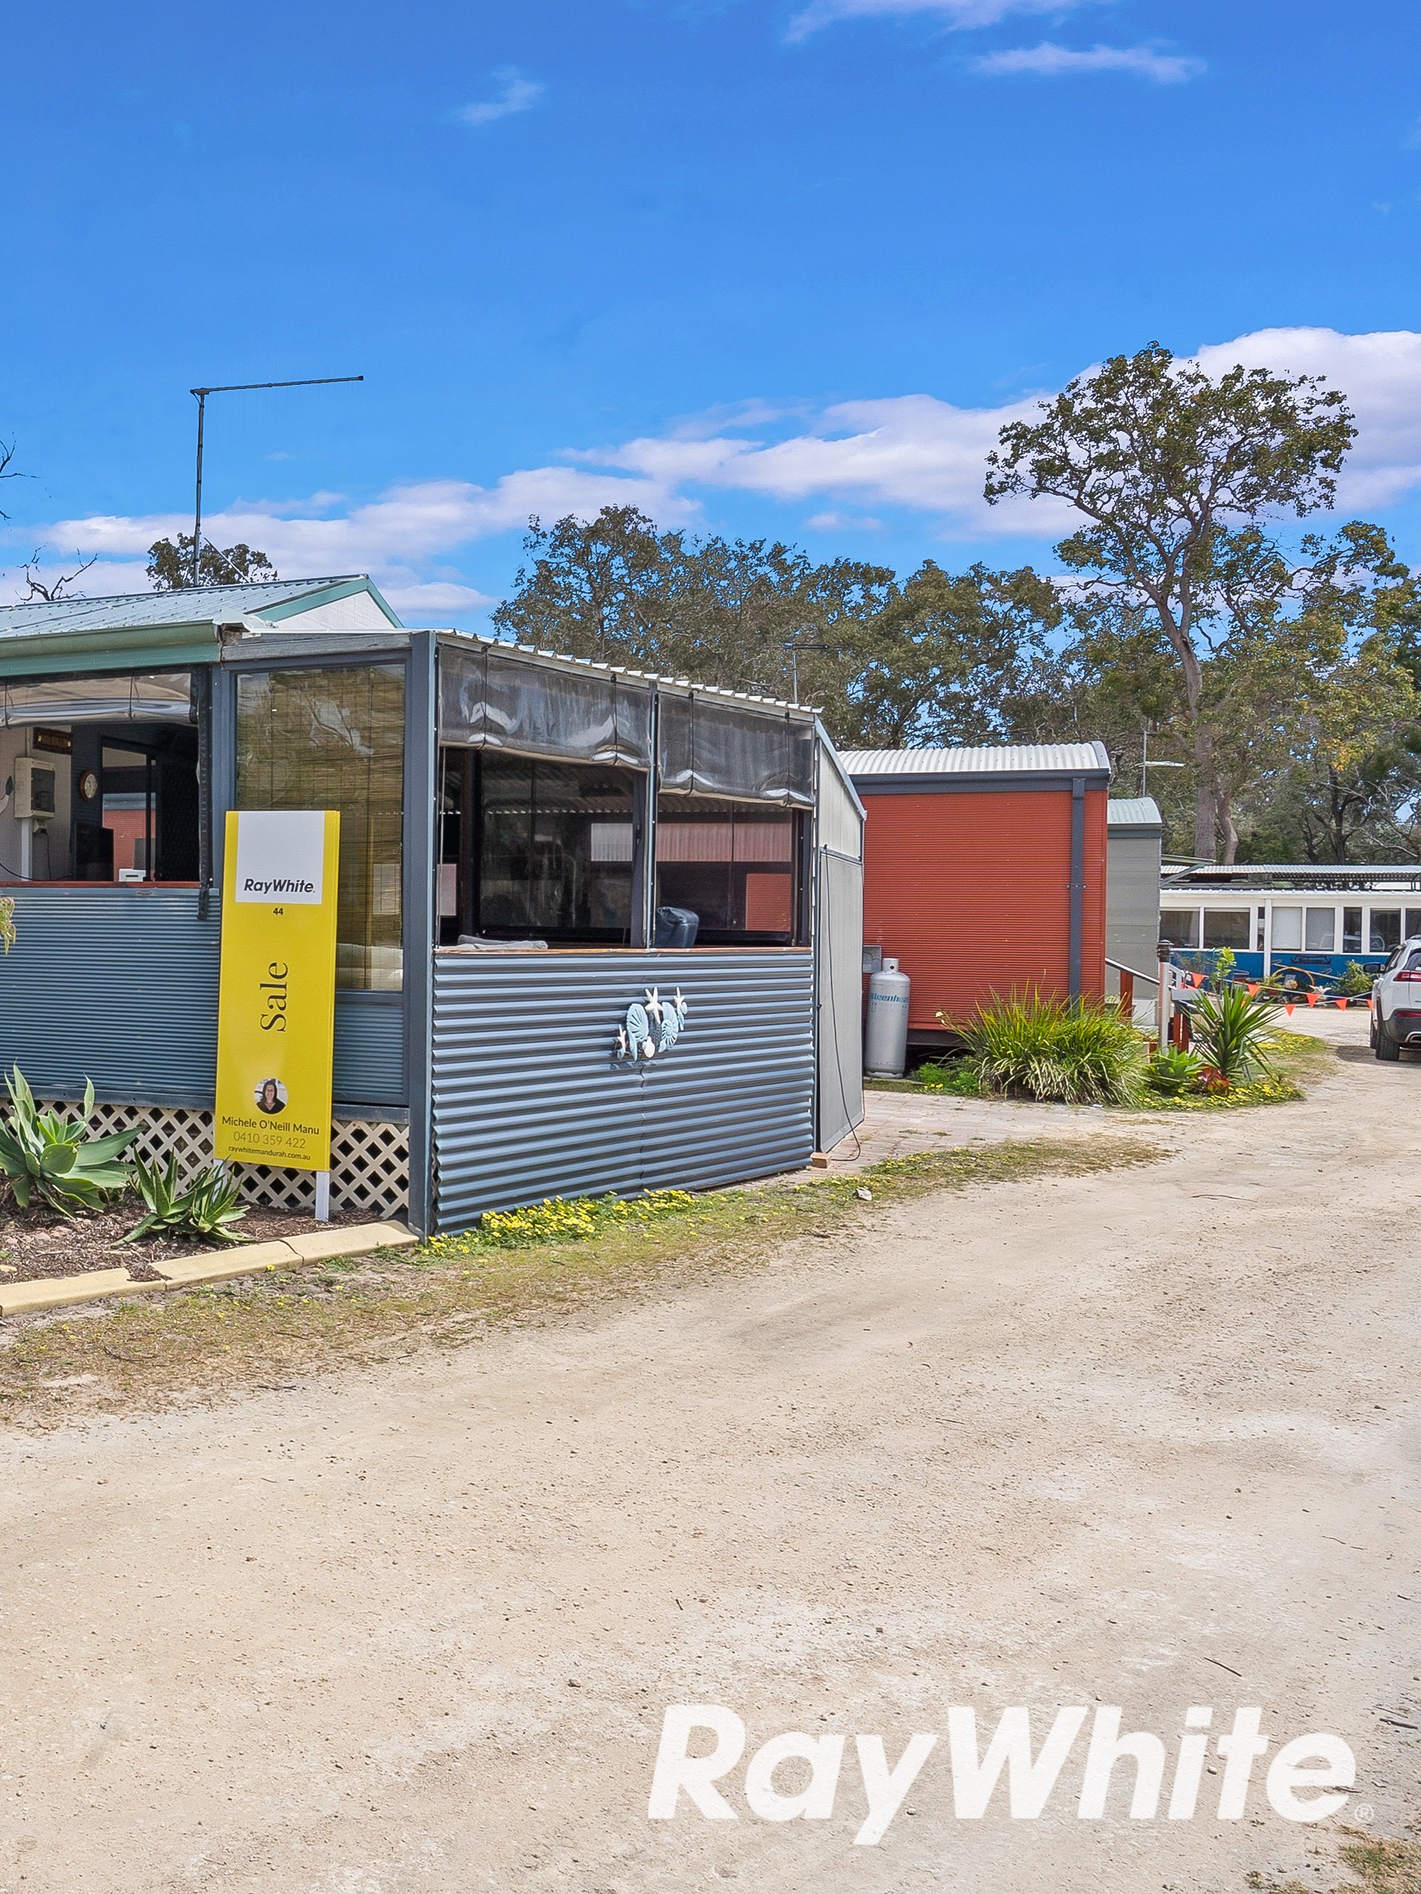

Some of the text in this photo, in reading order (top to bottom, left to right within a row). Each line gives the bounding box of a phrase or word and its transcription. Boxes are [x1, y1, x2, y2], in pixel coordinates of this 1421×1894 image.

[273, 907, 284, 915] 44
[259, 962, 288, 1032] Sale
[222, 1116, 320, 1135] Michele O'Neill Manu
[233, 1131, 306, 1149] 0410 359 422
[228, 1146, 311, 1160] raywhitemandurah.com.au
